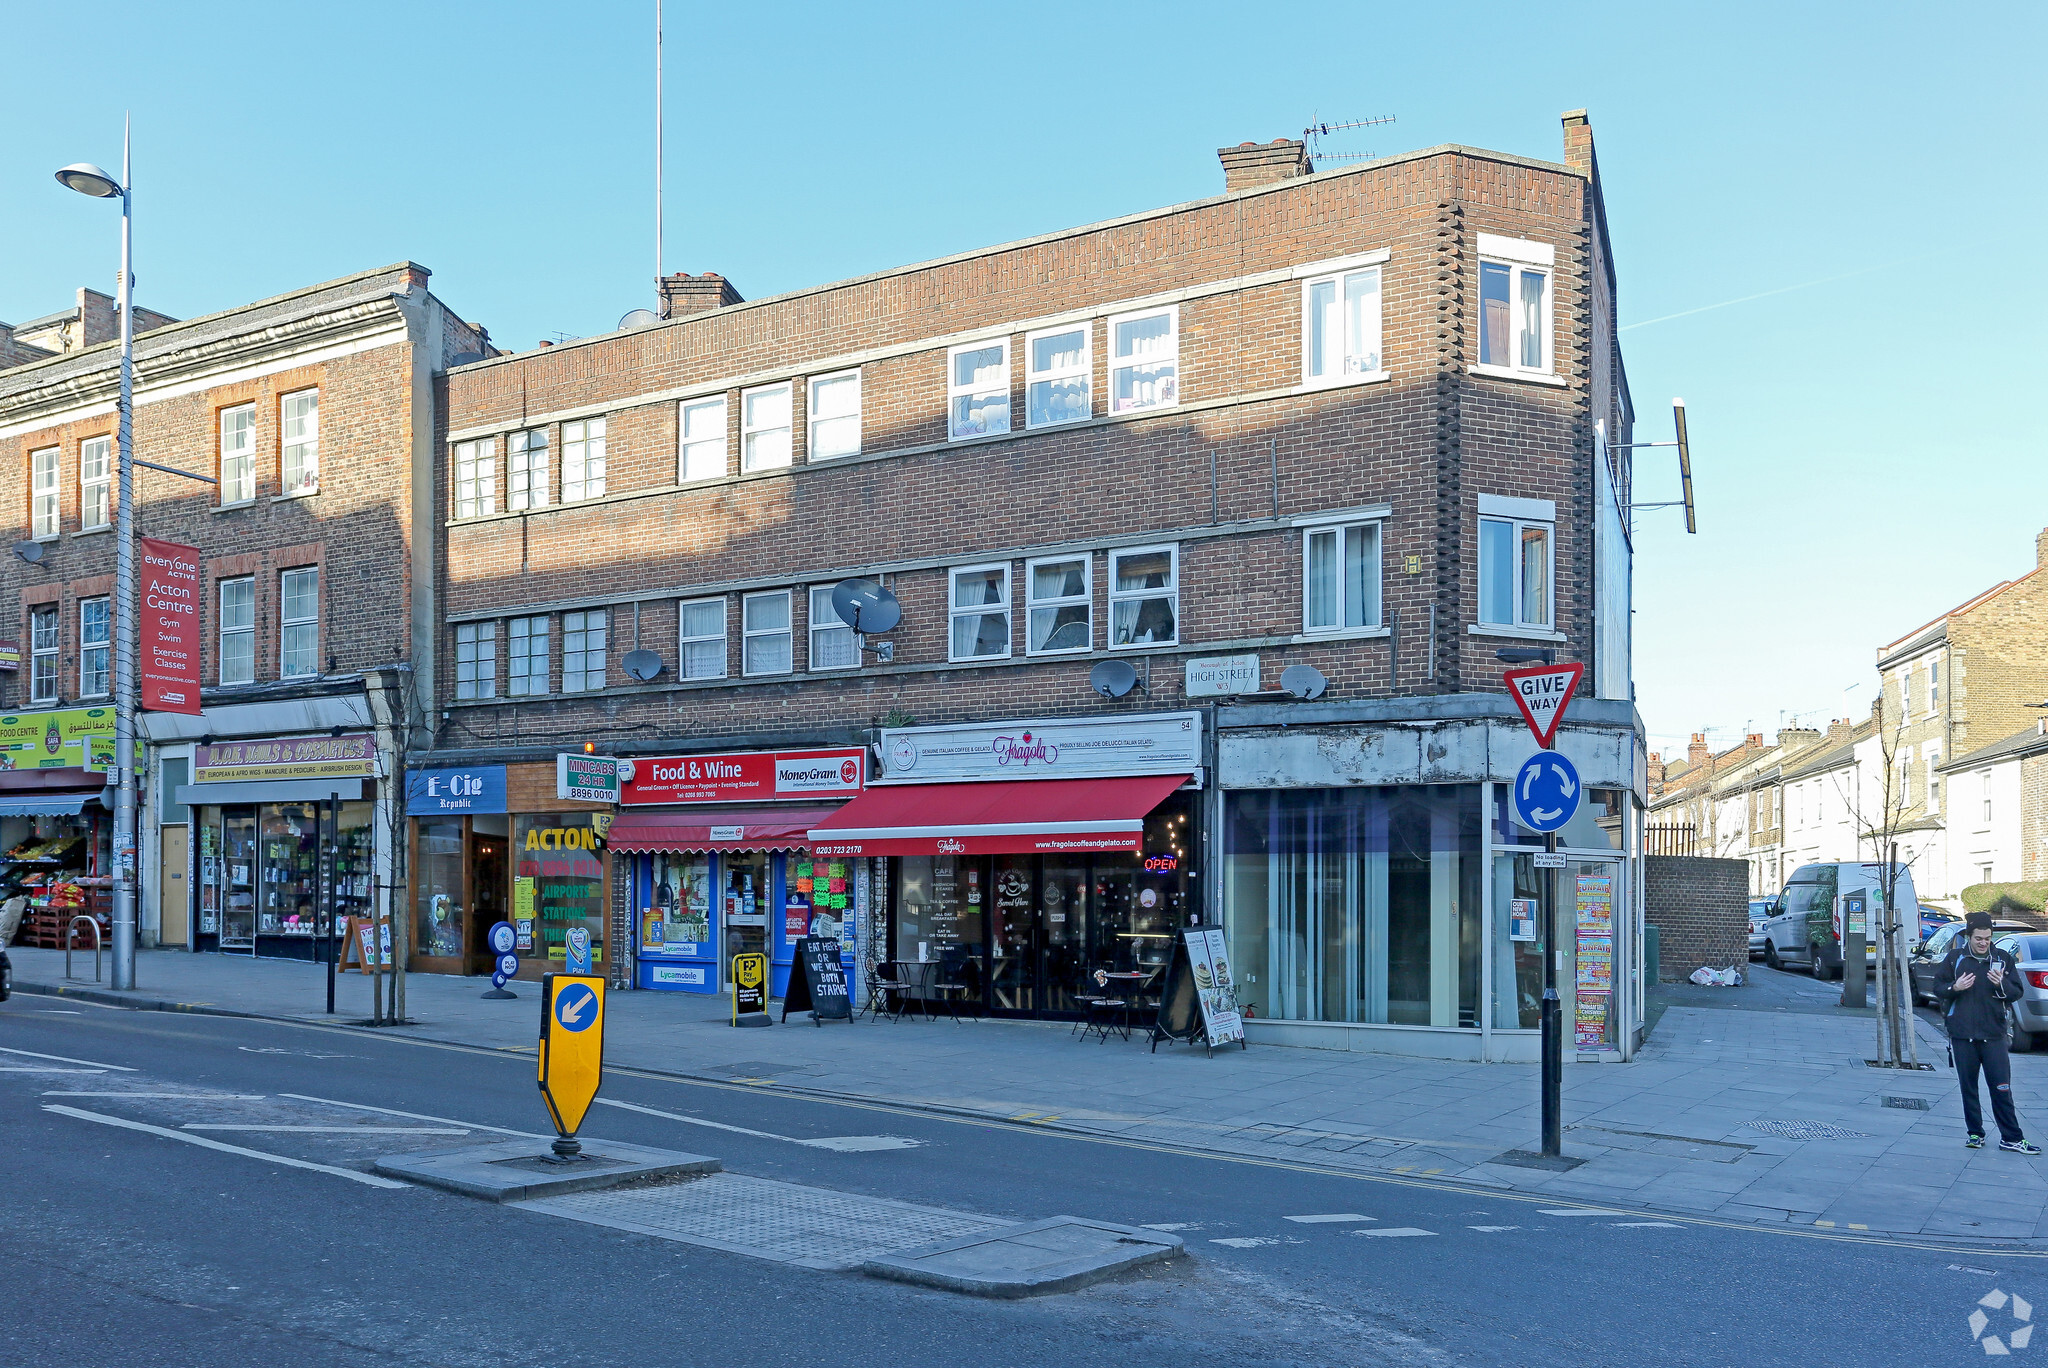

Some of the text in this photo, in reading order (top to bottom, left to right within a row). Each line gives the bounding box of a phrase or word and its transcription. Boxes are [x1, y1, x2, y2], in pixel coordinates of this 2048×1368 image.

[144, 555, 196, 572] everyone
[167, 570, 196, 581] ACTIVE
[149, 579, 190, 599] Acton
[146, 594, 194, 615] Centre
[159, 616, 180, 629] Gym
[158, 631, 182, 643] Swim
[152, 645, 188, 659] Exercise
[154, 657, 187, 670] Classes
[145, 673, 197, 685] everyoneactive.com
[1190, 667, 1256, 682] HIGH STREET
[1215, 682, 1229, 690] W3
[1521, 676, 1565, 695] GIVE
[1530, 697, 1559, 711] WAY
[1181, 721, 1190, 729] 54
[1, 726, 39, 737] FOOD CENTRE
[47, 737, 59, 745] SAFA
[1101, 739, 1122, 747] DELUCCI
[282, 744, 293, 762] &
[294, 738, 367, 761] COSMETICS
[993, 735, 1058, 767] Fragola
[208, 770, 231, 778] EUROPEAN
[264, 767, 288, 775] MANICURE
[293, 766, 316, 774] PEDICURE
[345, 764, 363, 772] DESIGN
[568, 758, 616, 775] MINICABS
[652, 761, 686, 781] Food
[689, 761, 701, 780] &
[704, 760, 742, 779] Wine
[427, 774, 483, 797] E-Cig
[577, 774, 606, 787] 24 HR
[653, 783, 669, 791] Grocers
[680, 782, 695, 790] Licence
[698, 782, 718, 790] Paypoint
[721, 781, 738, 789] Evening
[739, 780, 760, 788] Standard
[571, 788, 613, 800] 8896 0010
[440, 798, 471, 810] Republic
[525, 827, 596, 851] ACTON
[815, 845, 862, 854] 0203 723 2170
[936, 839, 965, 854] Fragola
[519, 859, 602, 876] 020 8896 0010
[1144, 858, 1178, 870] OPEN
[543, 884, 590, 899] AIRPORTS
[1577, 883, 1609, 892] FUNFAIR
[996, 897, 1015, 908] Served
[1852, 902, 1860, 910] P
[543, 906, 587, 920] STATIONS
[665, 944, 693, 952] Lycamobile
[807, 941, 839, 952] EAT HERE
[1578, 943, 1610, 953] FUNFAIR
[817, 953, 829, 963] OR
[811, 962, 843, 972] WE WILL
[660, 970, 697, 980] Lycamobile
[821, 972, 840, 983] BOTH
[816, 984, 847, 996] STARVE
